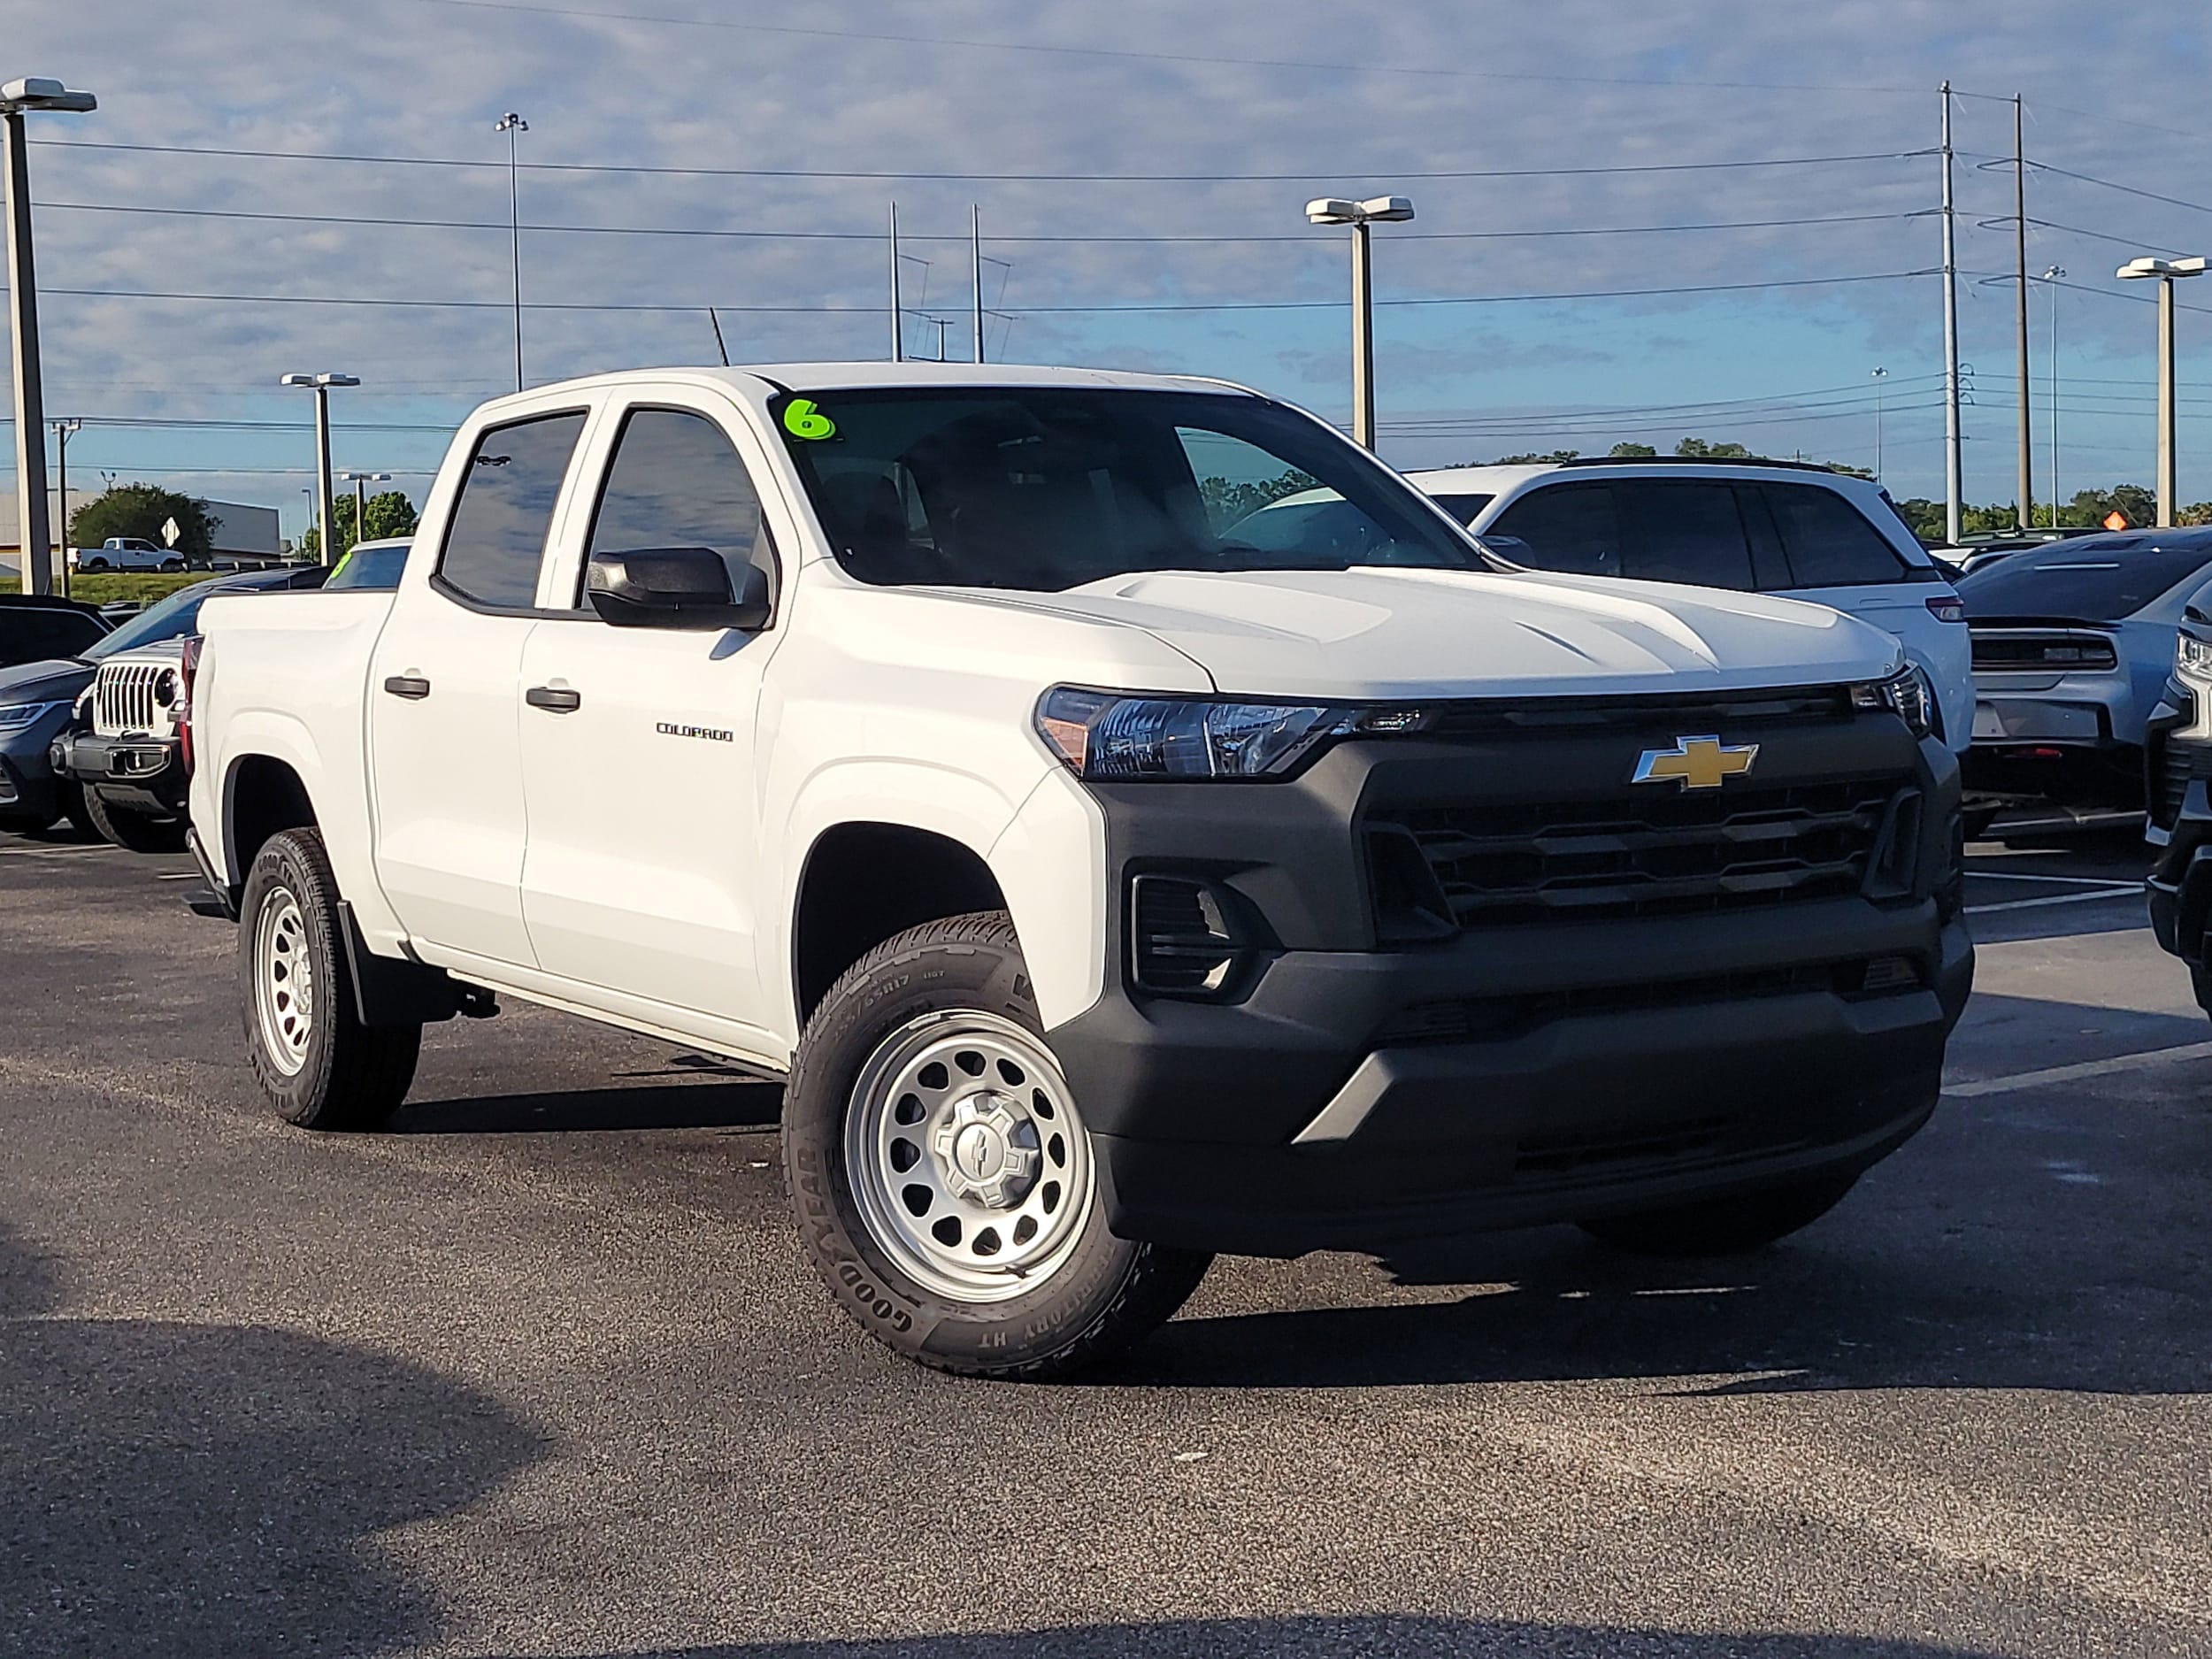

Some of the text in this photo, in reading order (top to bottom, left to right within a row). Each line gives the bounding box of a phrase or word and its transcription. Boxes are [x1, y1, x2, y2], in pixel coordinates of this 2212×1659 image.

[784, 398, 835, 441] 6
[657, 721, 733, 742] COLORADO
[796, 1147, 913, 1333] GOODYEAR
[977, 1243, 1117, 1349] TERRITORY HT
